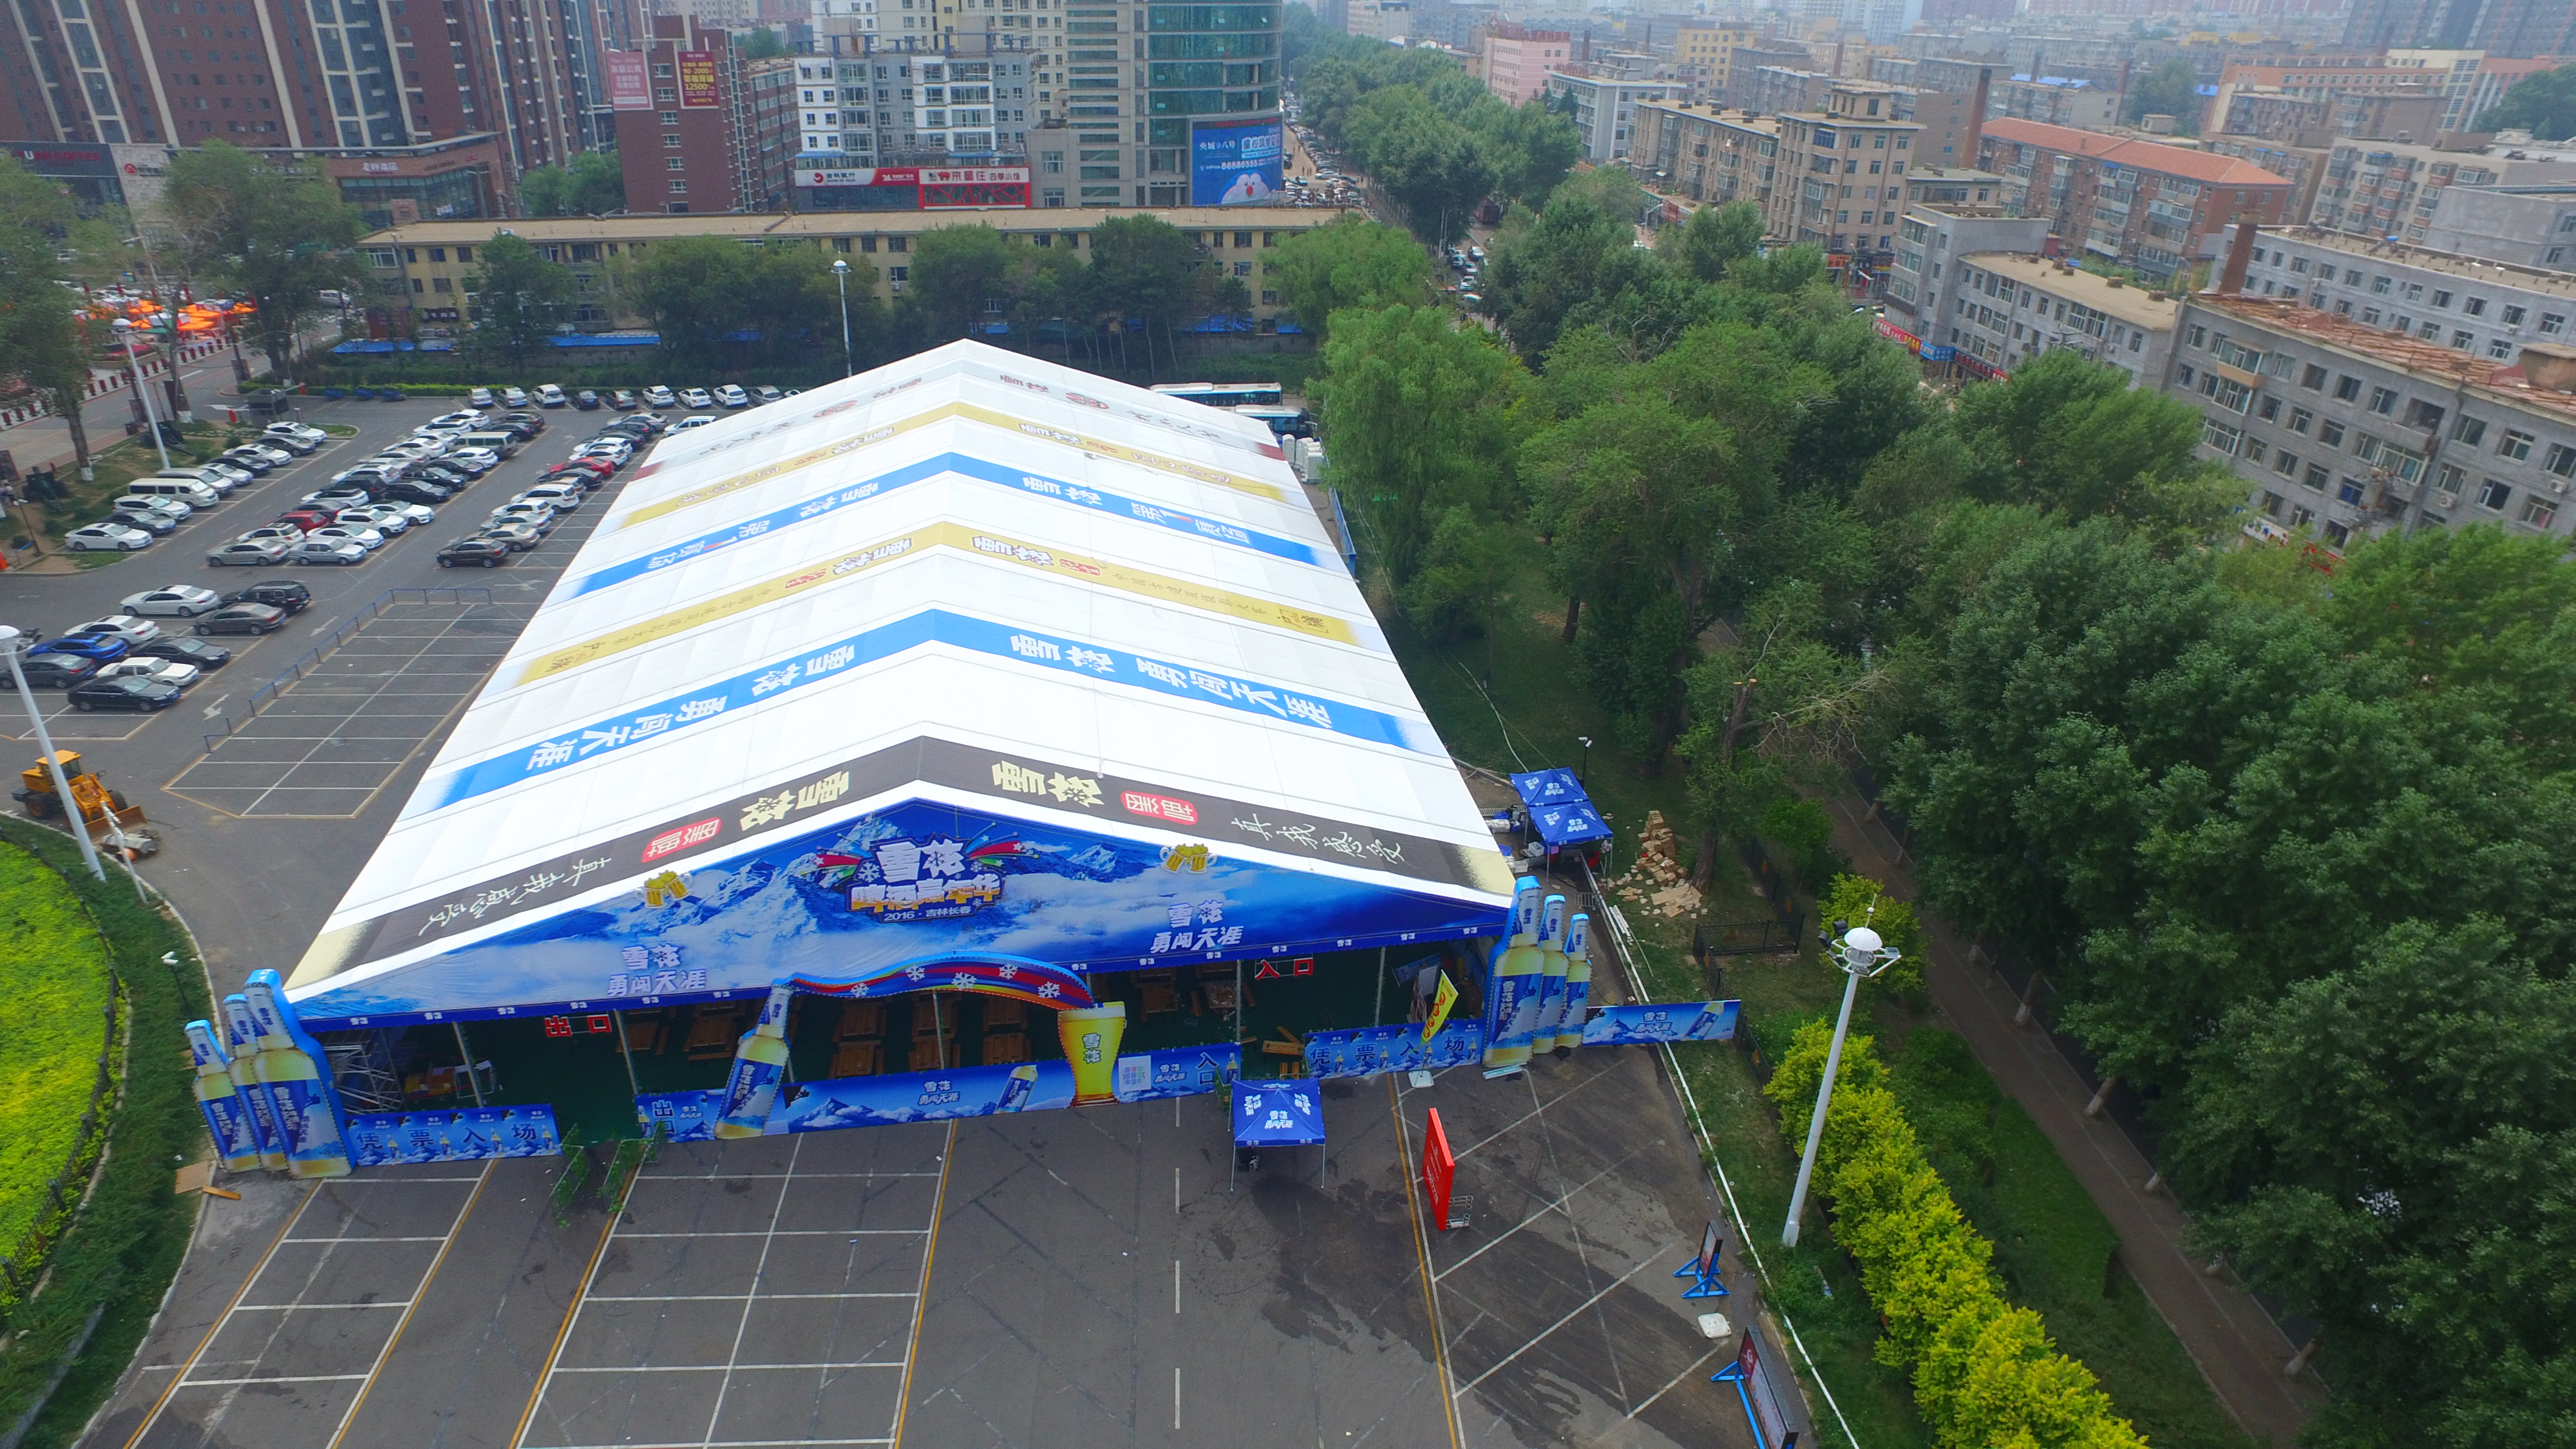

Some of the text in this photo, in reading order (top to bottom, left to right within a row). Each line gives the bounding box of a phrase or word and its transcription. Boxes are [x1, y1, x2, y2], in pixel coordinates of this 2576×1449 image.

[800, 482, 878, 518] 雪花
[1023, 476, 1102, 506] 雪花
[833, 538, 912, 576] 雪花
[972, 535, 1054, 567] 雪花
[1010, 633, 1115, 673] 雪花
[751, 643, 856, 697] 雪花
[1135, 658, 1334, 730] 勇闯天涯
[526, 695, 728, 772] 勇闯天涯
[991, 760, 1104, 808] 雪花
[739, 771, 850, 832] 雪花
[876, 838, 966, 883] 雪花
[851, 873, 1001, 913] 啤酒嘉年华
[884, 905, 971, 922] 2016 吉林长春
[1166, 900, 1224, 928] 雪花
[1150, 925, 1244, 955] 勇闯天涯
[621, 943, 683, 971] 雪花
[1255, 957, 1314, 980] 入口
[606, 968, 706, 998] 勇闯天涯
[544, 1015, 612, 1038] 出口
[1083, 1033, 1102, 1064] 雪花
[357, 1122, 538, 1151] 凭票入场
